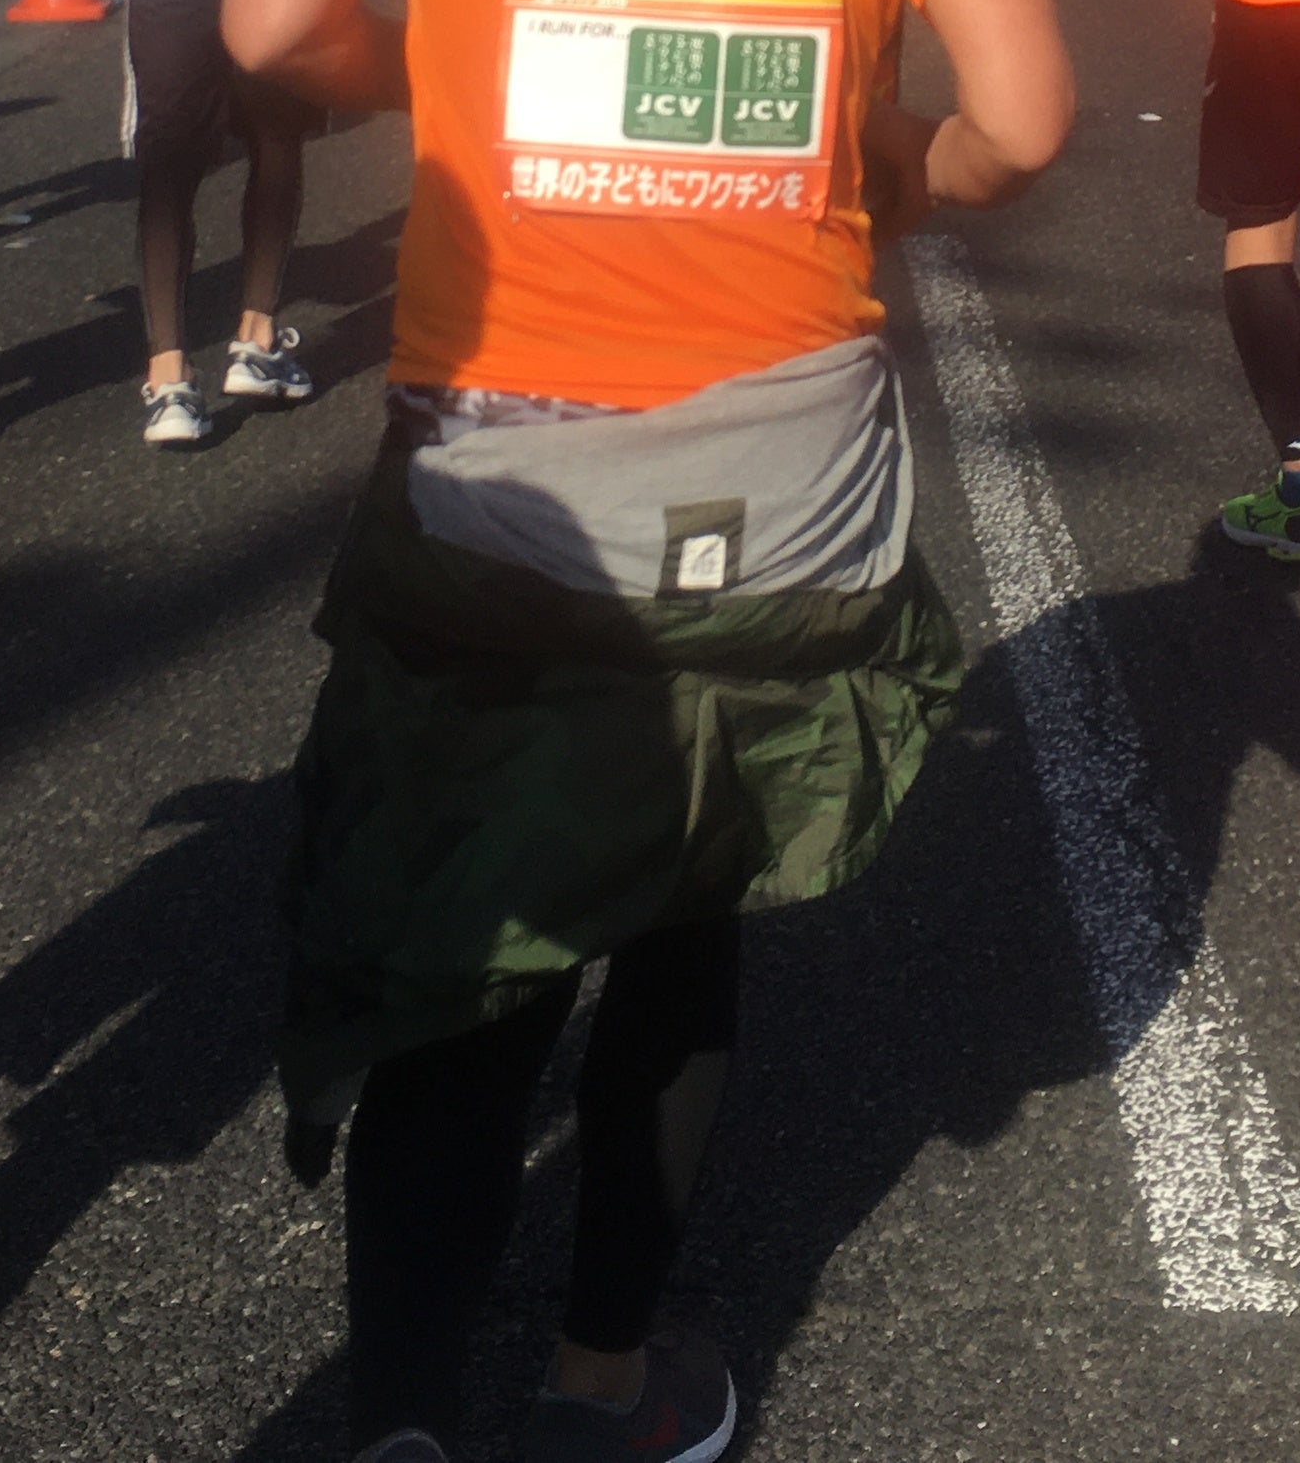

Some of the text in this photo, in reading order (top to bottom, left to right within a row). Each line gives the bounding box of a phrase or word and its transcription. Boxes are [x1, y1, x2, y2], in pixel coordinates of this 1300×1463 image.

[635, 93, 702, 117] JCV
[733, 99, 800, 121] JCV
[511, 156, 804, 209] 世界の子どもにワクチンを
